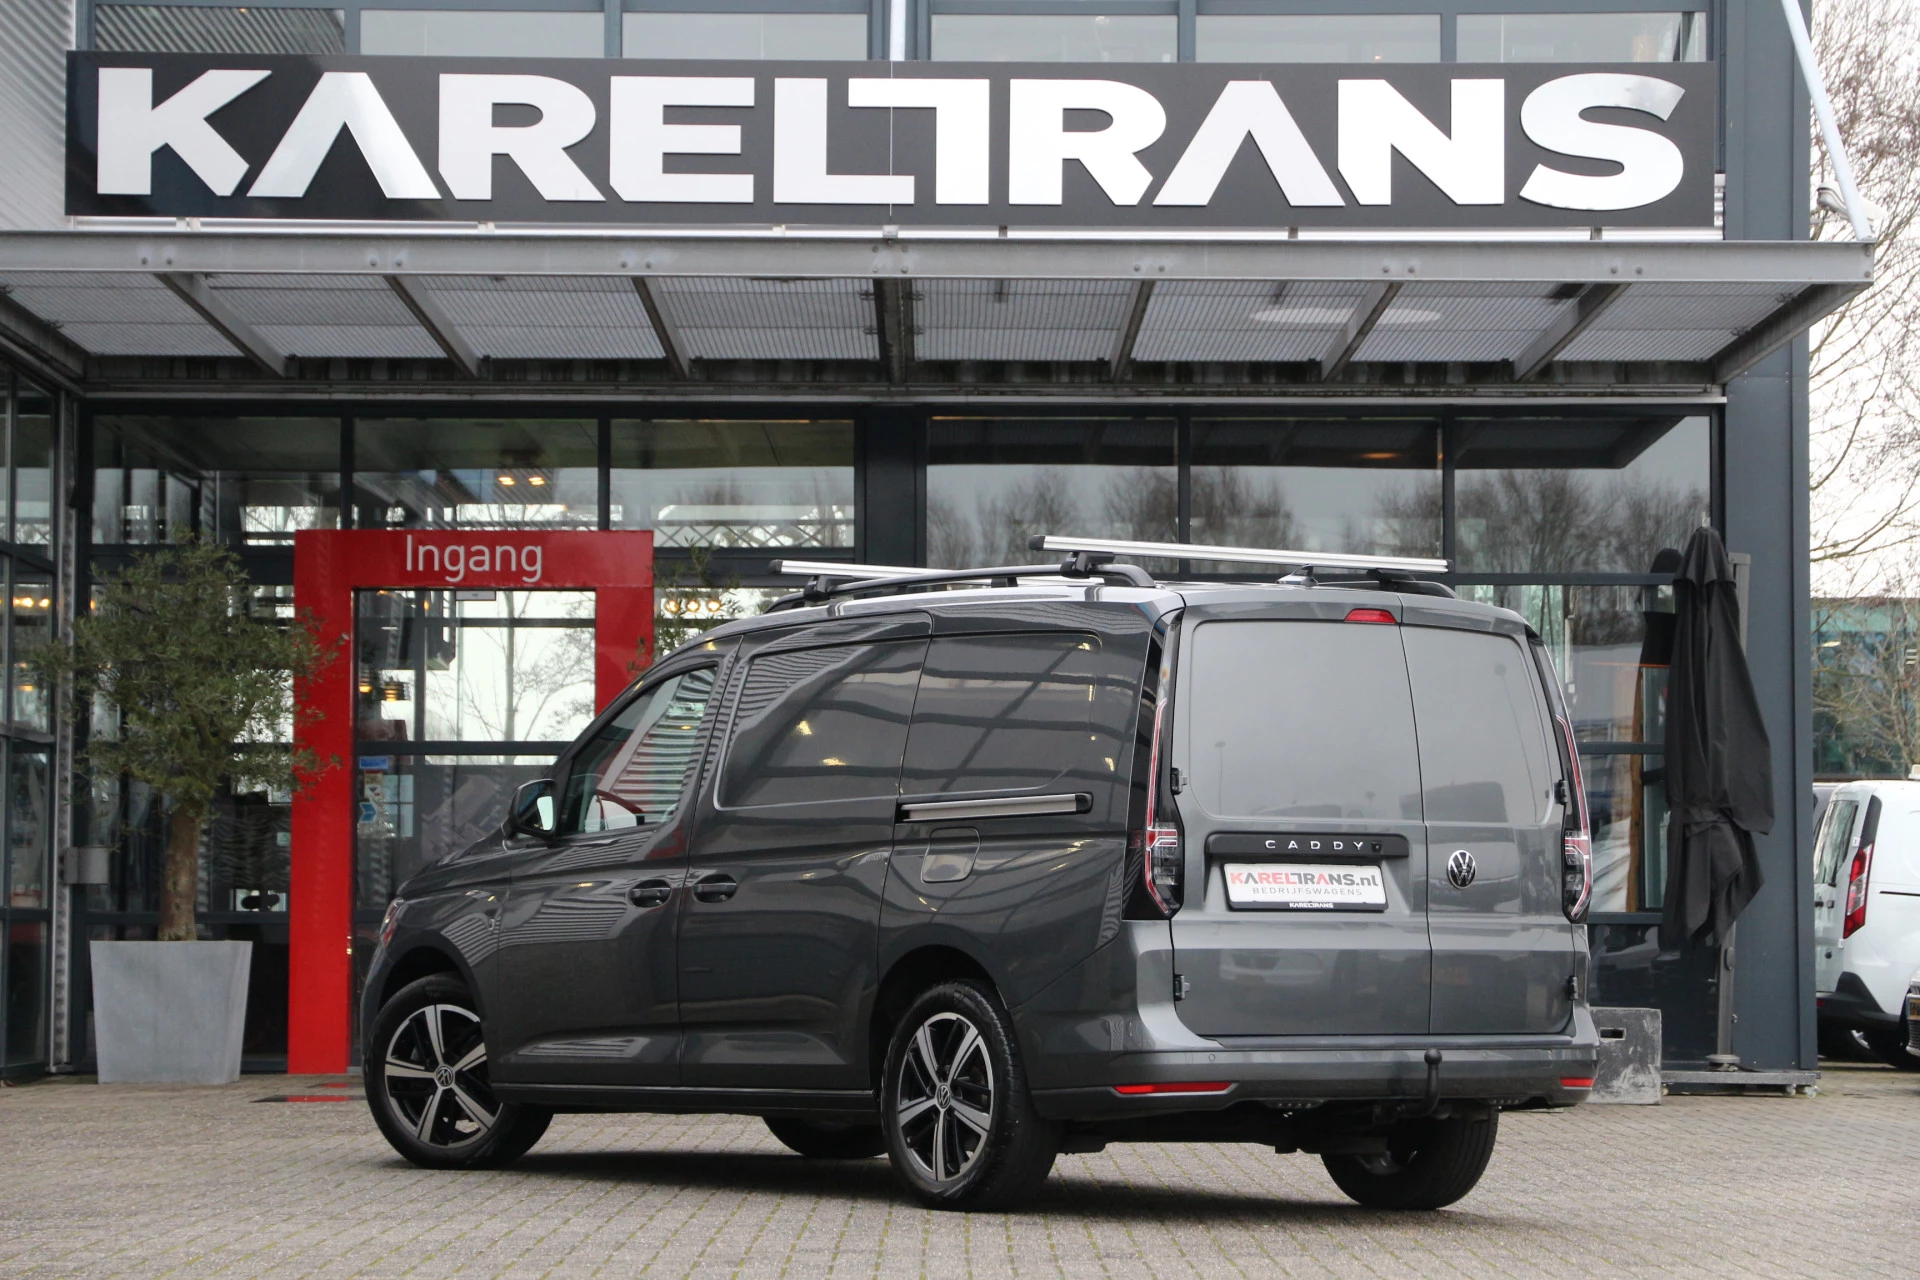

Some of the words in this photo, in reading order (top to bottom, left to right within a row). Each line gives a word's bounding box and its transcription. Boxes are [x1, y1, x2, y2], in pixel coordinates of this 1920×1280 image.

[97, 67, 1686, 211] KARELTRANS
[406, 534, 542, 583] Ingang
[1265, 840, 1364, 850] CADDY
[1230, 872, 1379, 887] KARELTRANS.nl
[1252, 887, 1363, 896] BEDRIJFSWAGENS
